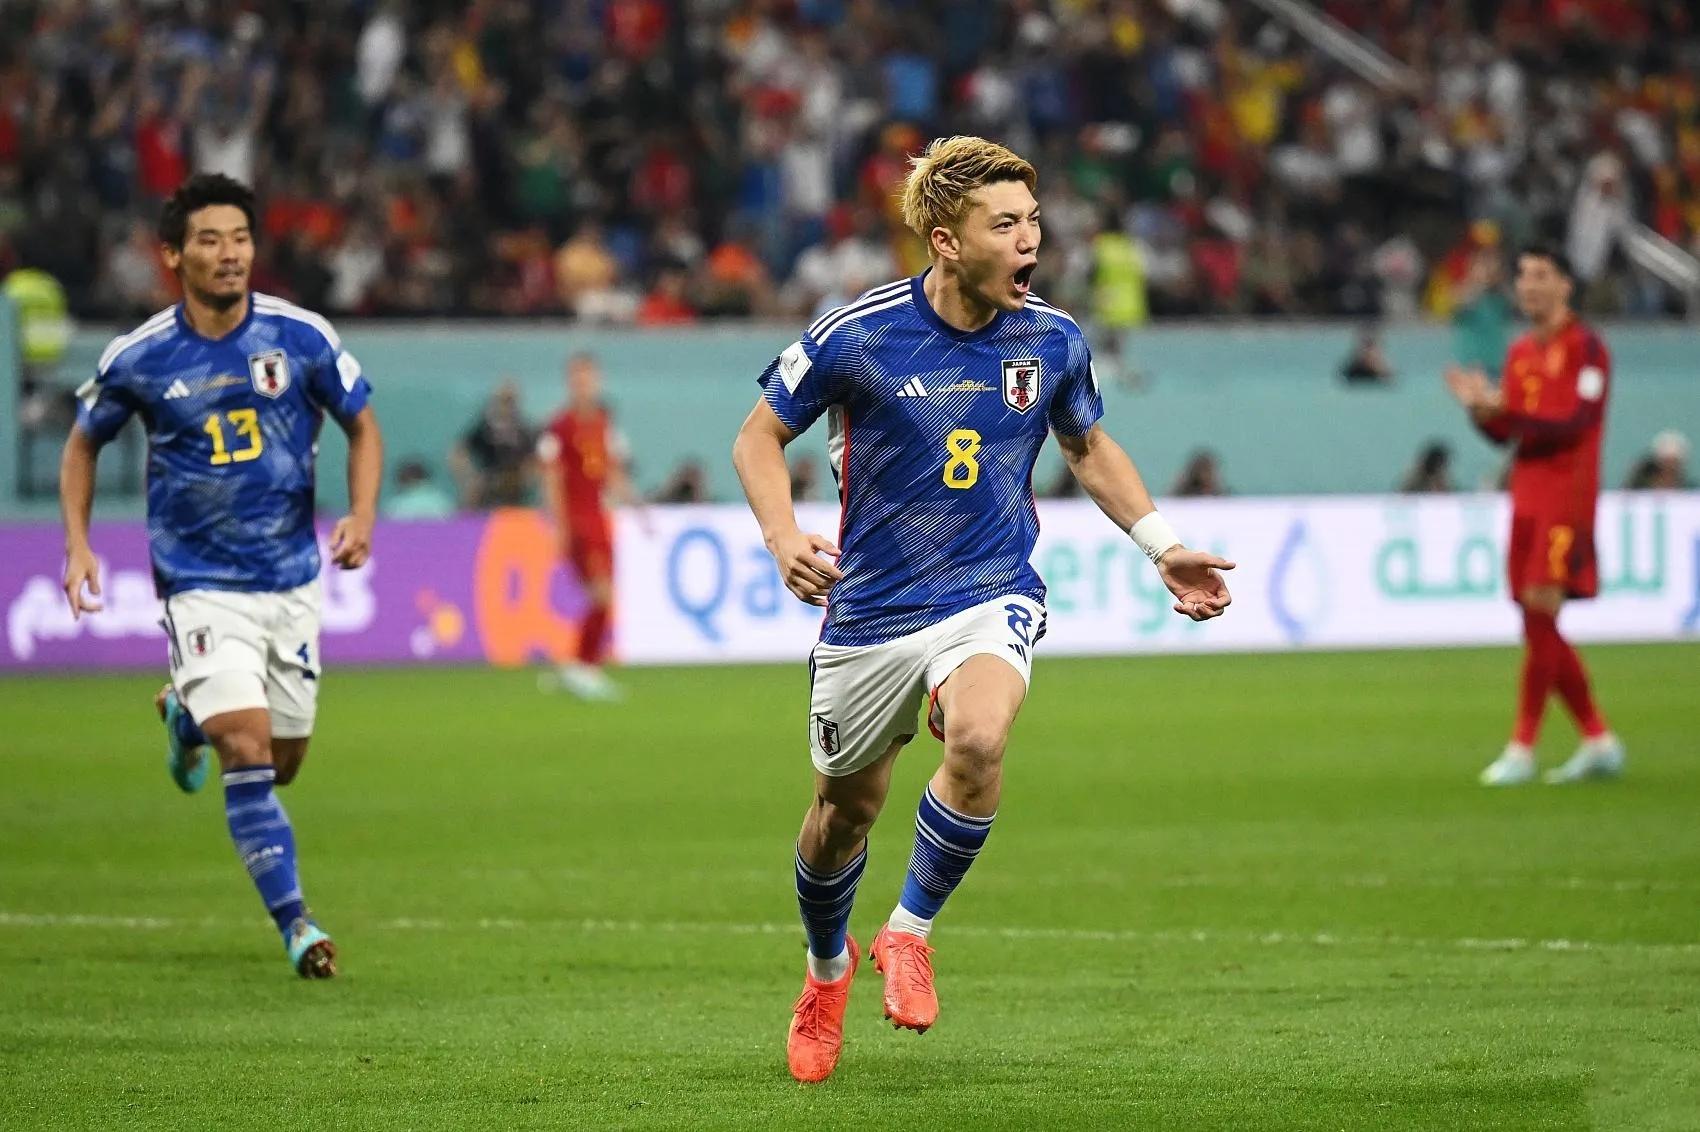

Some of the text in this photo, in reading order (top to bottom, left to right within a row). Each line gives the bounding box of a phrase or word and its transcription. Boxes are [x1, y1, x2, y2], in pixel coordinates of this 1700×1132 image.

[204, 408, 263, 464] 13
[943, 429, 981, 489] 8
[1004, 603, 1033, 646] 8
